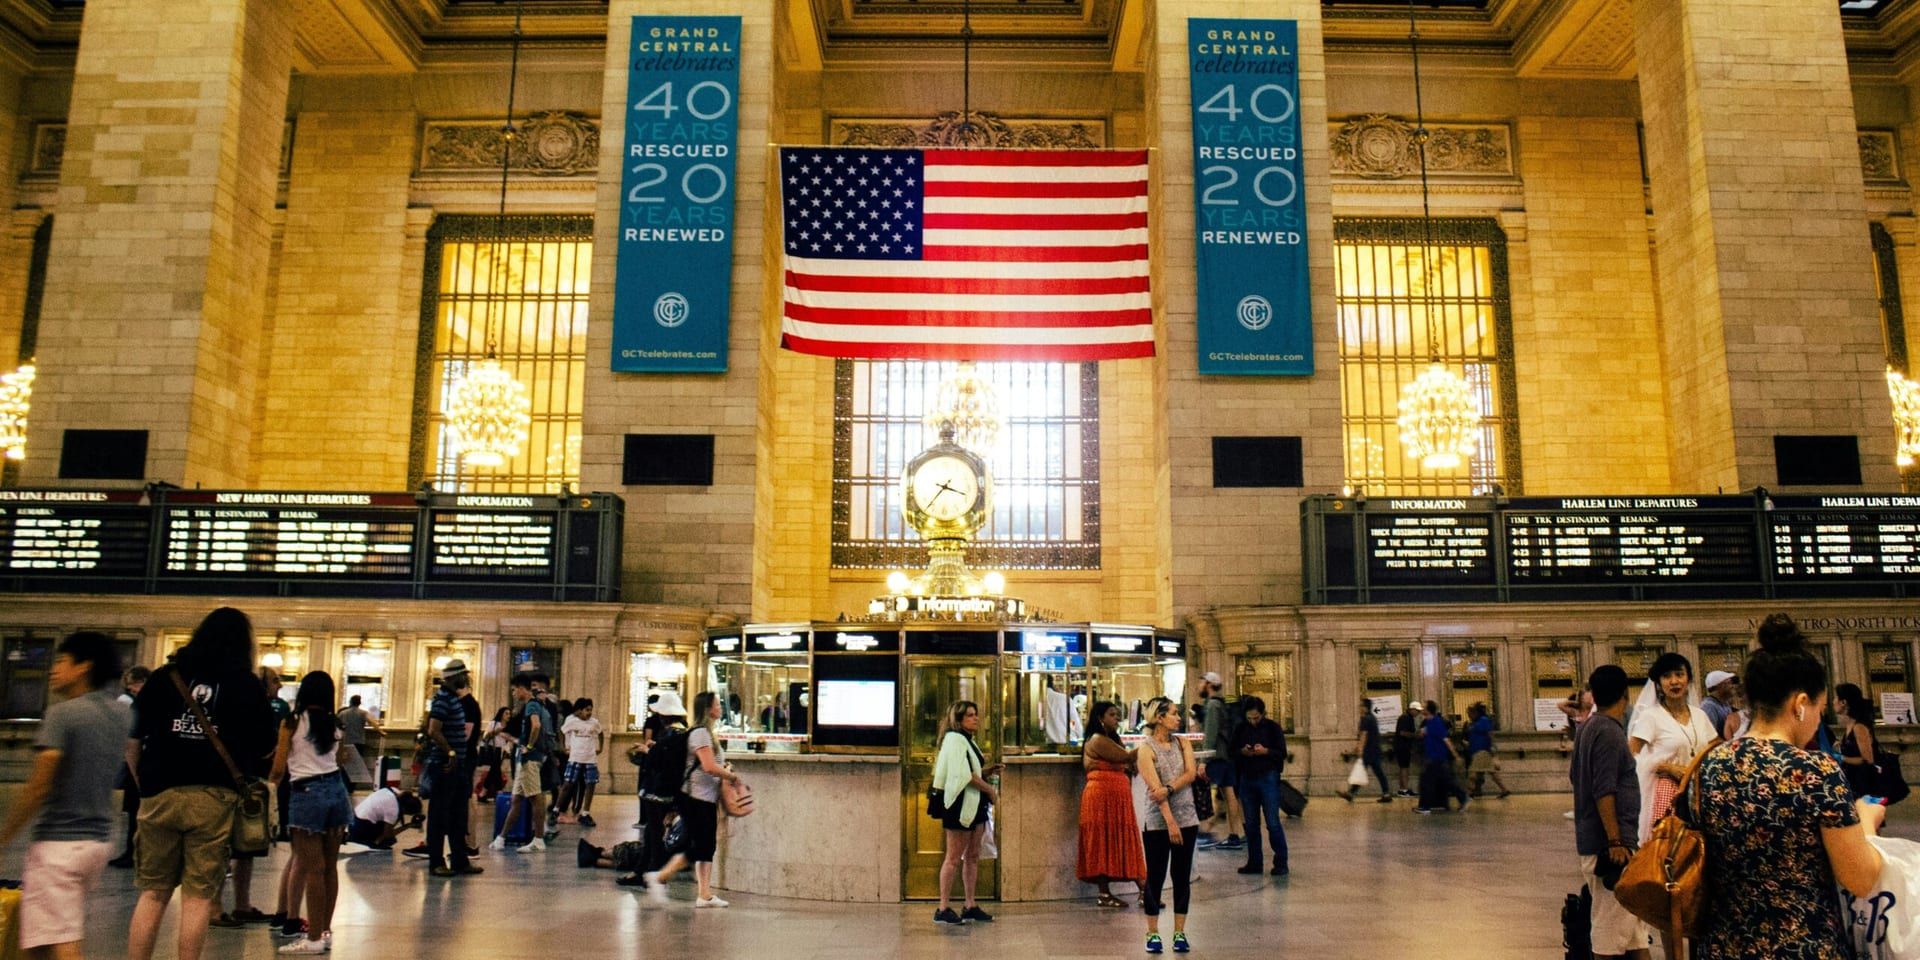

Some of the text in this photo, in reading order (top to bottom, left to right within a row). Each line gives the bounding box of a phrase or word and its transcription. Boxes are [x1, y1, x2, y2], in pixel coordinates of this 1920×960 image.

[650, 28, 718, 38] GRAND
[1208, 30, 1276, 41] GRAND
[640, 41, 731, 52] CENTRAL
[1198, 44, 1290, 55] CENTRAL
[634, 52, 735, 72] celebrates
[1195, 55, 1295, 75] celebrates
[634, 81, 731, 120] 40
[1198, 84, 1294, 123] 40
[633, 122, 728, 141] YEARS
[1199, 125, 1295, 144] YEARS
[631, 144, 728, 157] RESCUED
[1199, 147, 1296, 160] RESCUED
[628, 163, 727, 204] 20
[1202, 166, 1296, 206] 20
[628, 206, 726, 225] YEARS
[1202, 209, 1300, 227] YEARS
[625, 229, 725, 242] RENEWED
[1202, 231, 1300, 245] RENEWED
[621, 349, 717, 360] GCTcelebrates.com
[1209, 352, 1304, 362] GCTcelebrates.com
[20, 492, 43, 501] LINE
[44, 492, 108, 501] DEPARTURES
[216, 494, 371, 504] NEW HAVEN LINE DEPARTURES
[457, 496, 533, 507] INFORMATION
[1822, 498, 1864, 506] HARLEM
[1867, 498, 1890, 506] LINE
[1391, 500, 1466, 509] INFORMATION
[1562, 499, 1698, 508] HARLEM LINE DEPARTURES
[170, 510, 318, 518] TIME TRK DESTINATION REMARKS
[917, 597, 995, 612] Information
[172, 719, 219, 736] BEASS
